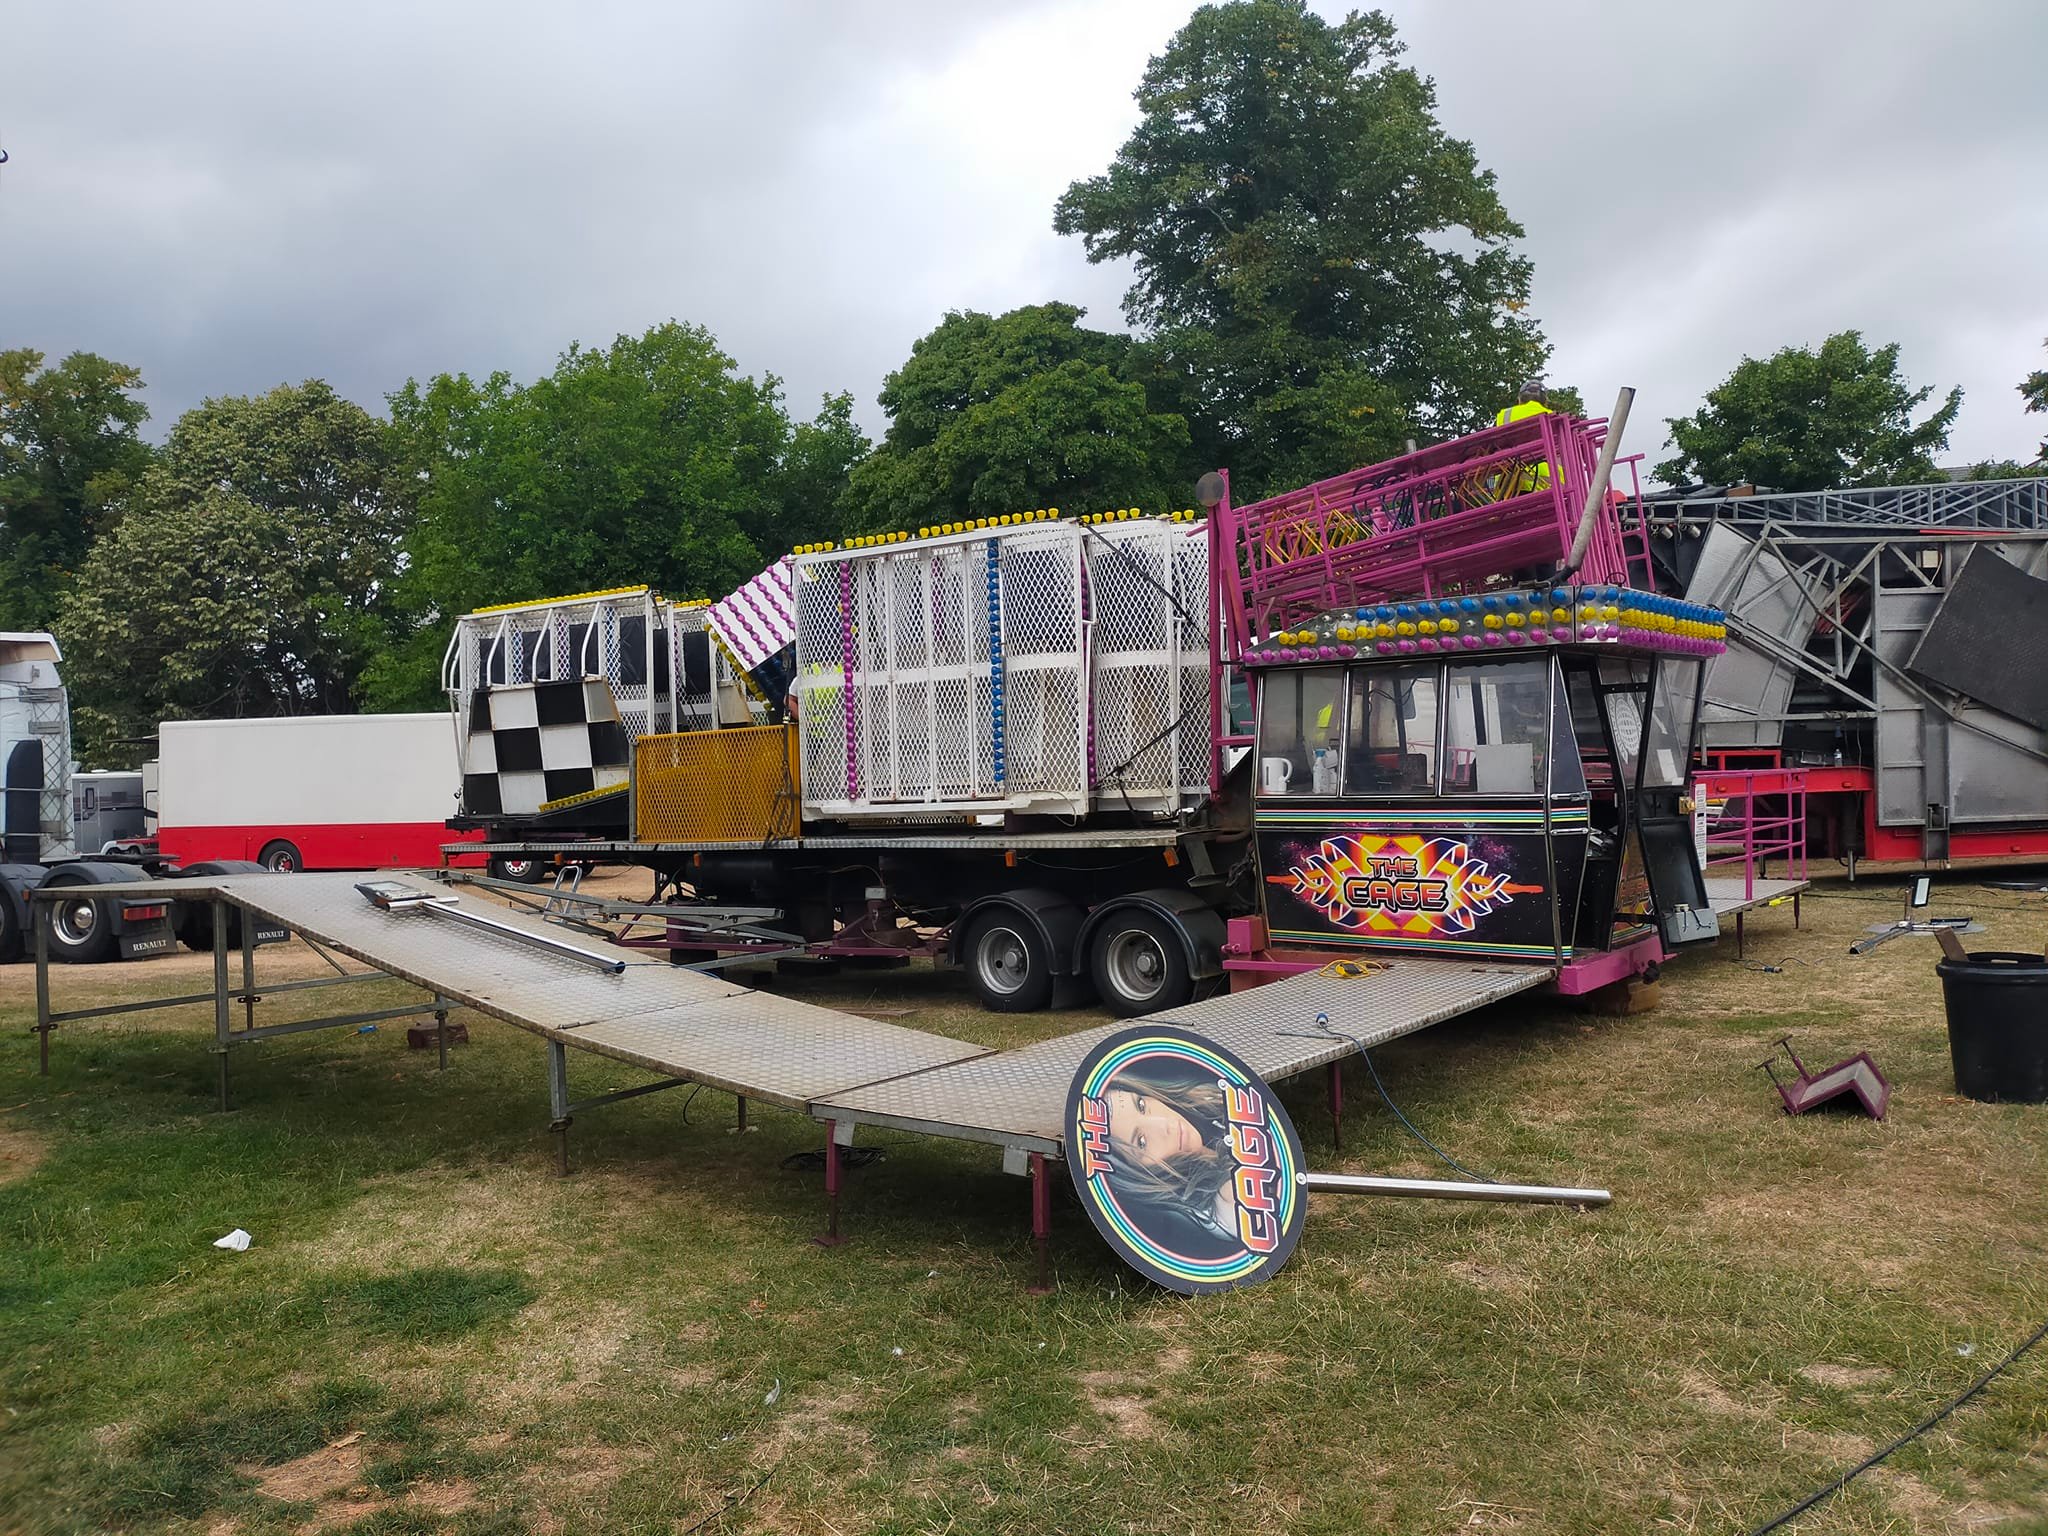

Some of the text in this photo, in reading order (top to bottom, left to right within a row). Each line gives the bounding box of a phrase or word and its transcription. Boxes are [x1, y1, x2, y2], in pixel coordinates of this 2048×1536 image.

[1367, 857, 1418, 878] THE
[1344, 878, 1448, 912] CAGE
[132, 939, 167, 951] RENAULT
[257, 930, 284, 940] RENAULT
[1082, 1096, 1114, 1178] THE
[1224, 1085, 1279, 1253] CAGE
